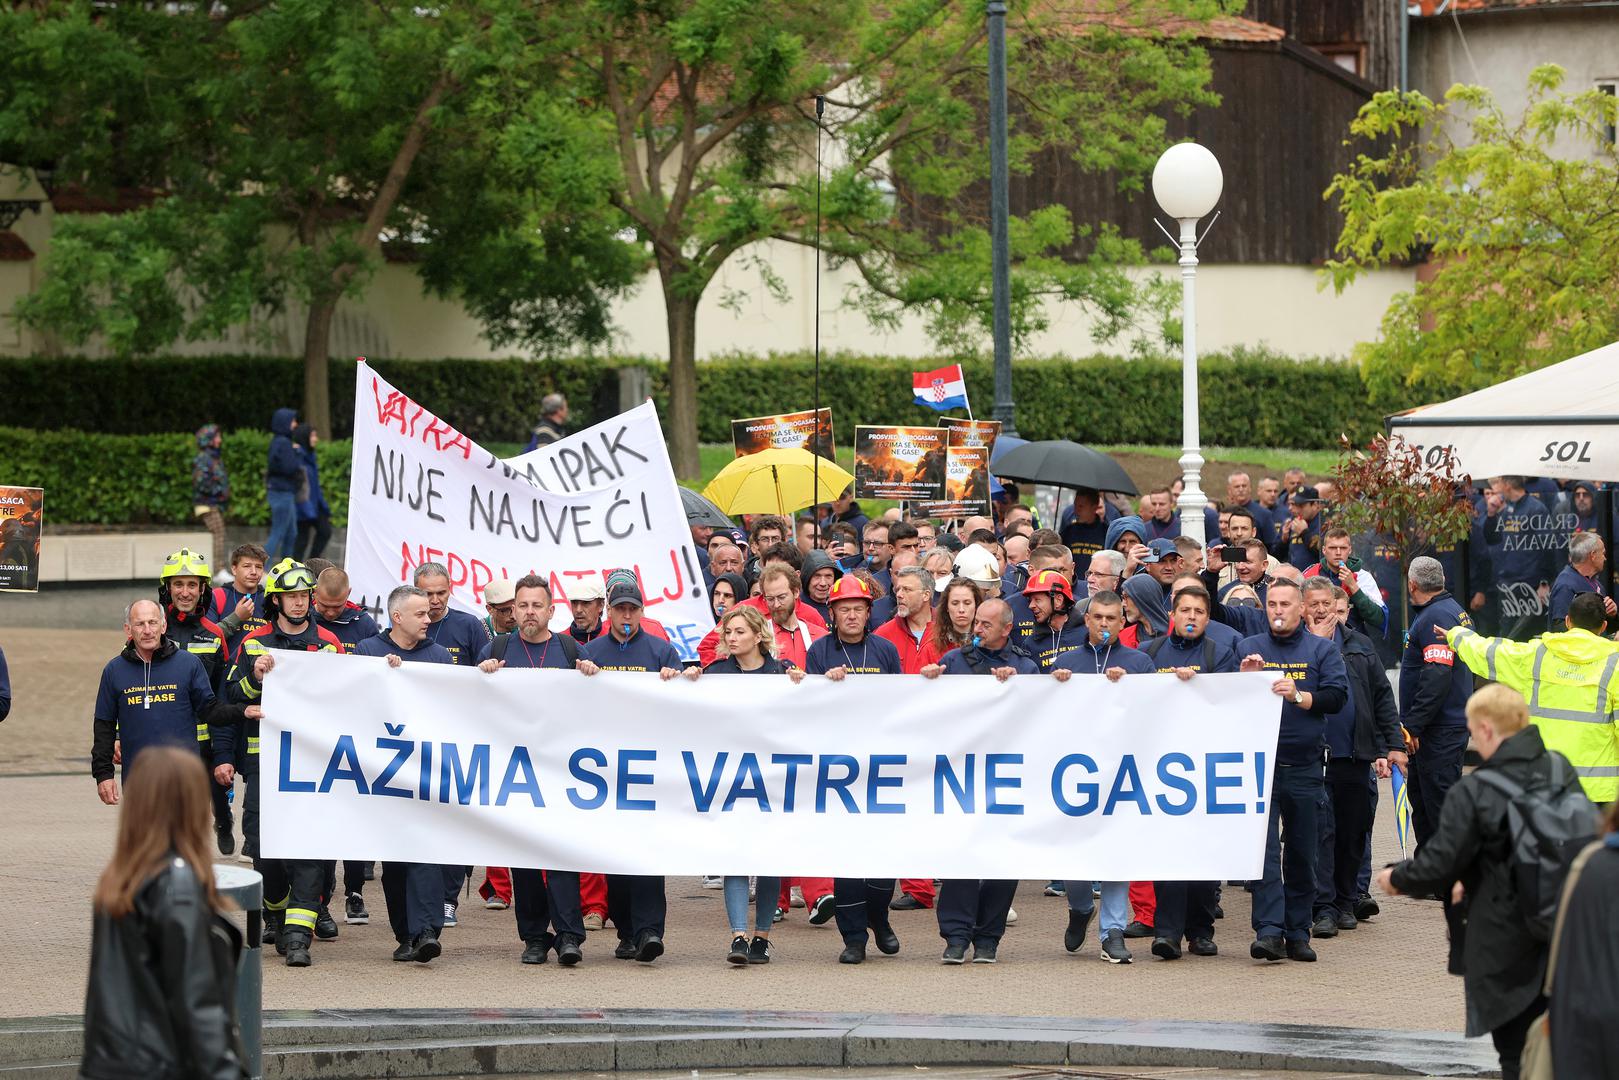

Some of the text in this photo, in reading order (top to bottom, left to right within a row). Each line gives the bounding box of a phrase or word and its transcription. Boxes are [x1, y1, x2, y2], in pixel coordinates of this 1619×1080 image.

[550, 425, 648, 494] IPAK
[1539, 441, 1592, 463] SOL
[371, 445, 446, 523] NIJE
[469, 484, 652, 548] NAJVEĆI
[1285, 671, 1306, 680] ASE
[124, 685, 147, 694] LAŽIMA
[127, 694, 176, 705] NE GASE
[278, 722, 1266, 817] LAŽIMA SE VATRE NE GASE!
